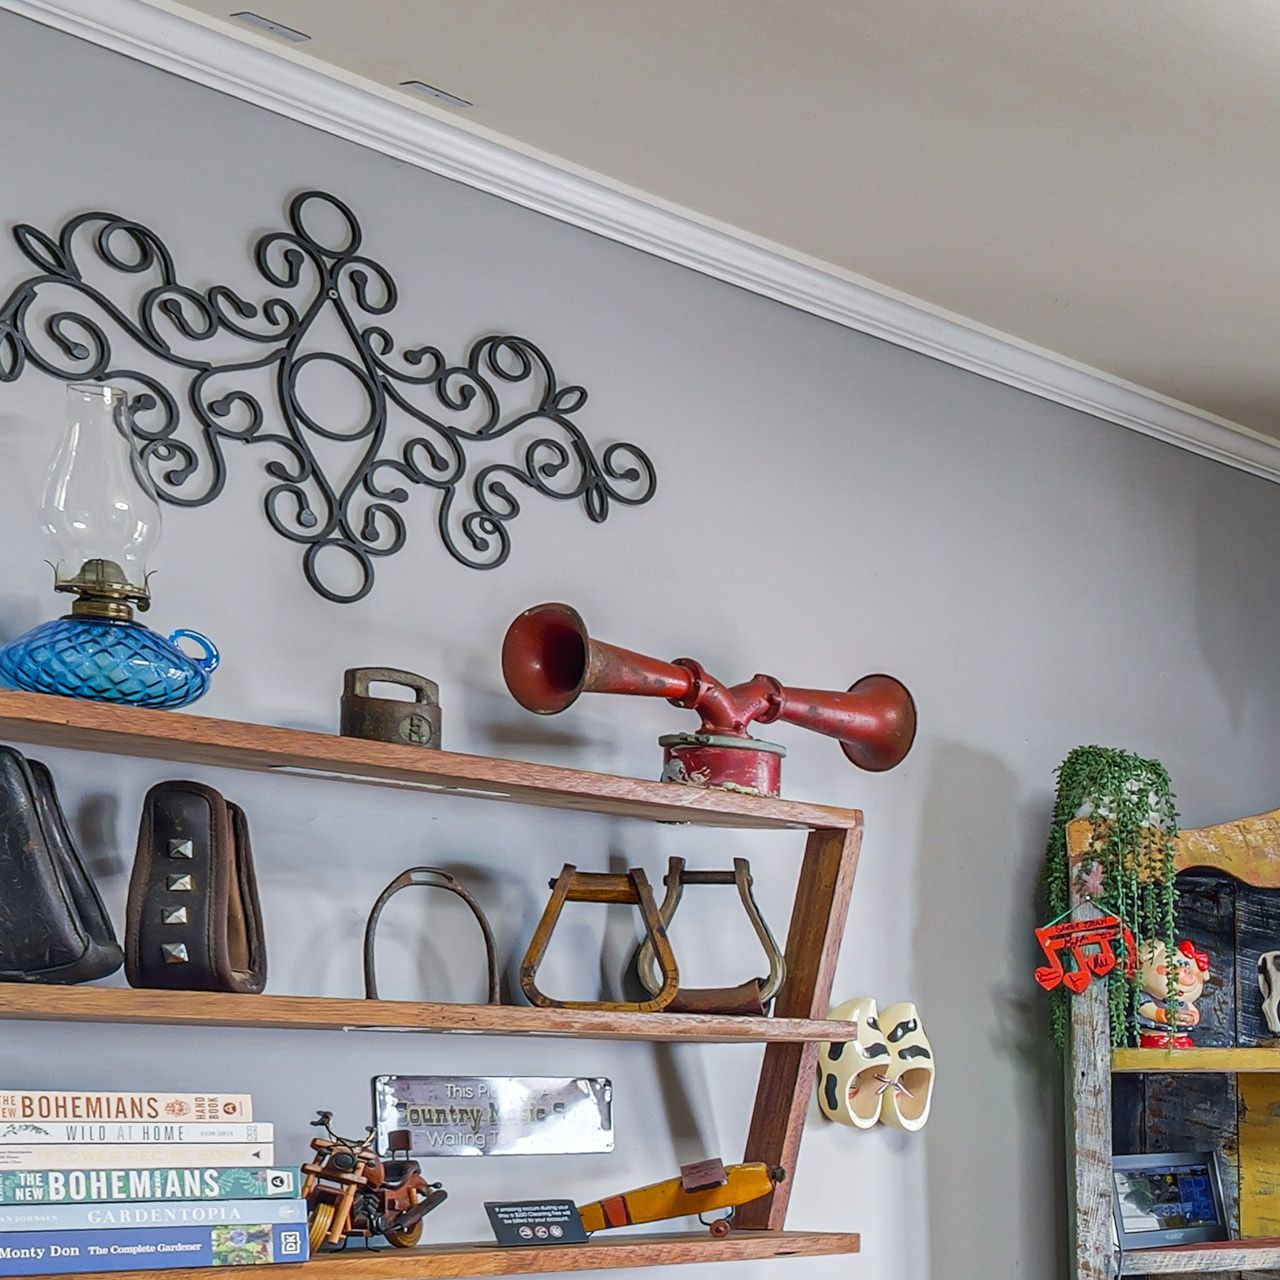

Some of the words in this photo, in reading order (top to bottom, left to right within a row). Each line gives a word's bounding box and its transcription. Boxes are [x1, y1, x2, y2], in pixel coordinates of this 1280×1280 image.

[446, 1084, 473, 1098] This
[1, 1107, 17, 1119] EW
[21, 1095, 160, 1119] BOHEMIANS
[195, 1096, 206, 1120] HAND
[208, 1096, 219, 1120] BOOK
[396, 1102, 482, 1131] Country
[489, 1102, 547, 1124] Msic
[66, 1125, 106, 1141] WILD
[117, 1125, 134, 1141] AT
[142, 1125, 185, 1141] HOME
[427, 1130, 487, 1148] Waiting
[19, 1172, 43, 1187] THE
[47, 1168, 220, 1201] BOHEMIANS
[15, 1187, 44, 1201] NEW
[87, 1206, 242, 1224] GARDENTOPIA
[0, 1246, 46, 1260] Monty
[50, 1245, 80, 1257] Don
[88, 1245, 109, 1255] The
[110, 1243, 157, 1255] Complete
[157, 1241, 203, 1253] Gardener
[284, 1233, 298, 1252] DK
